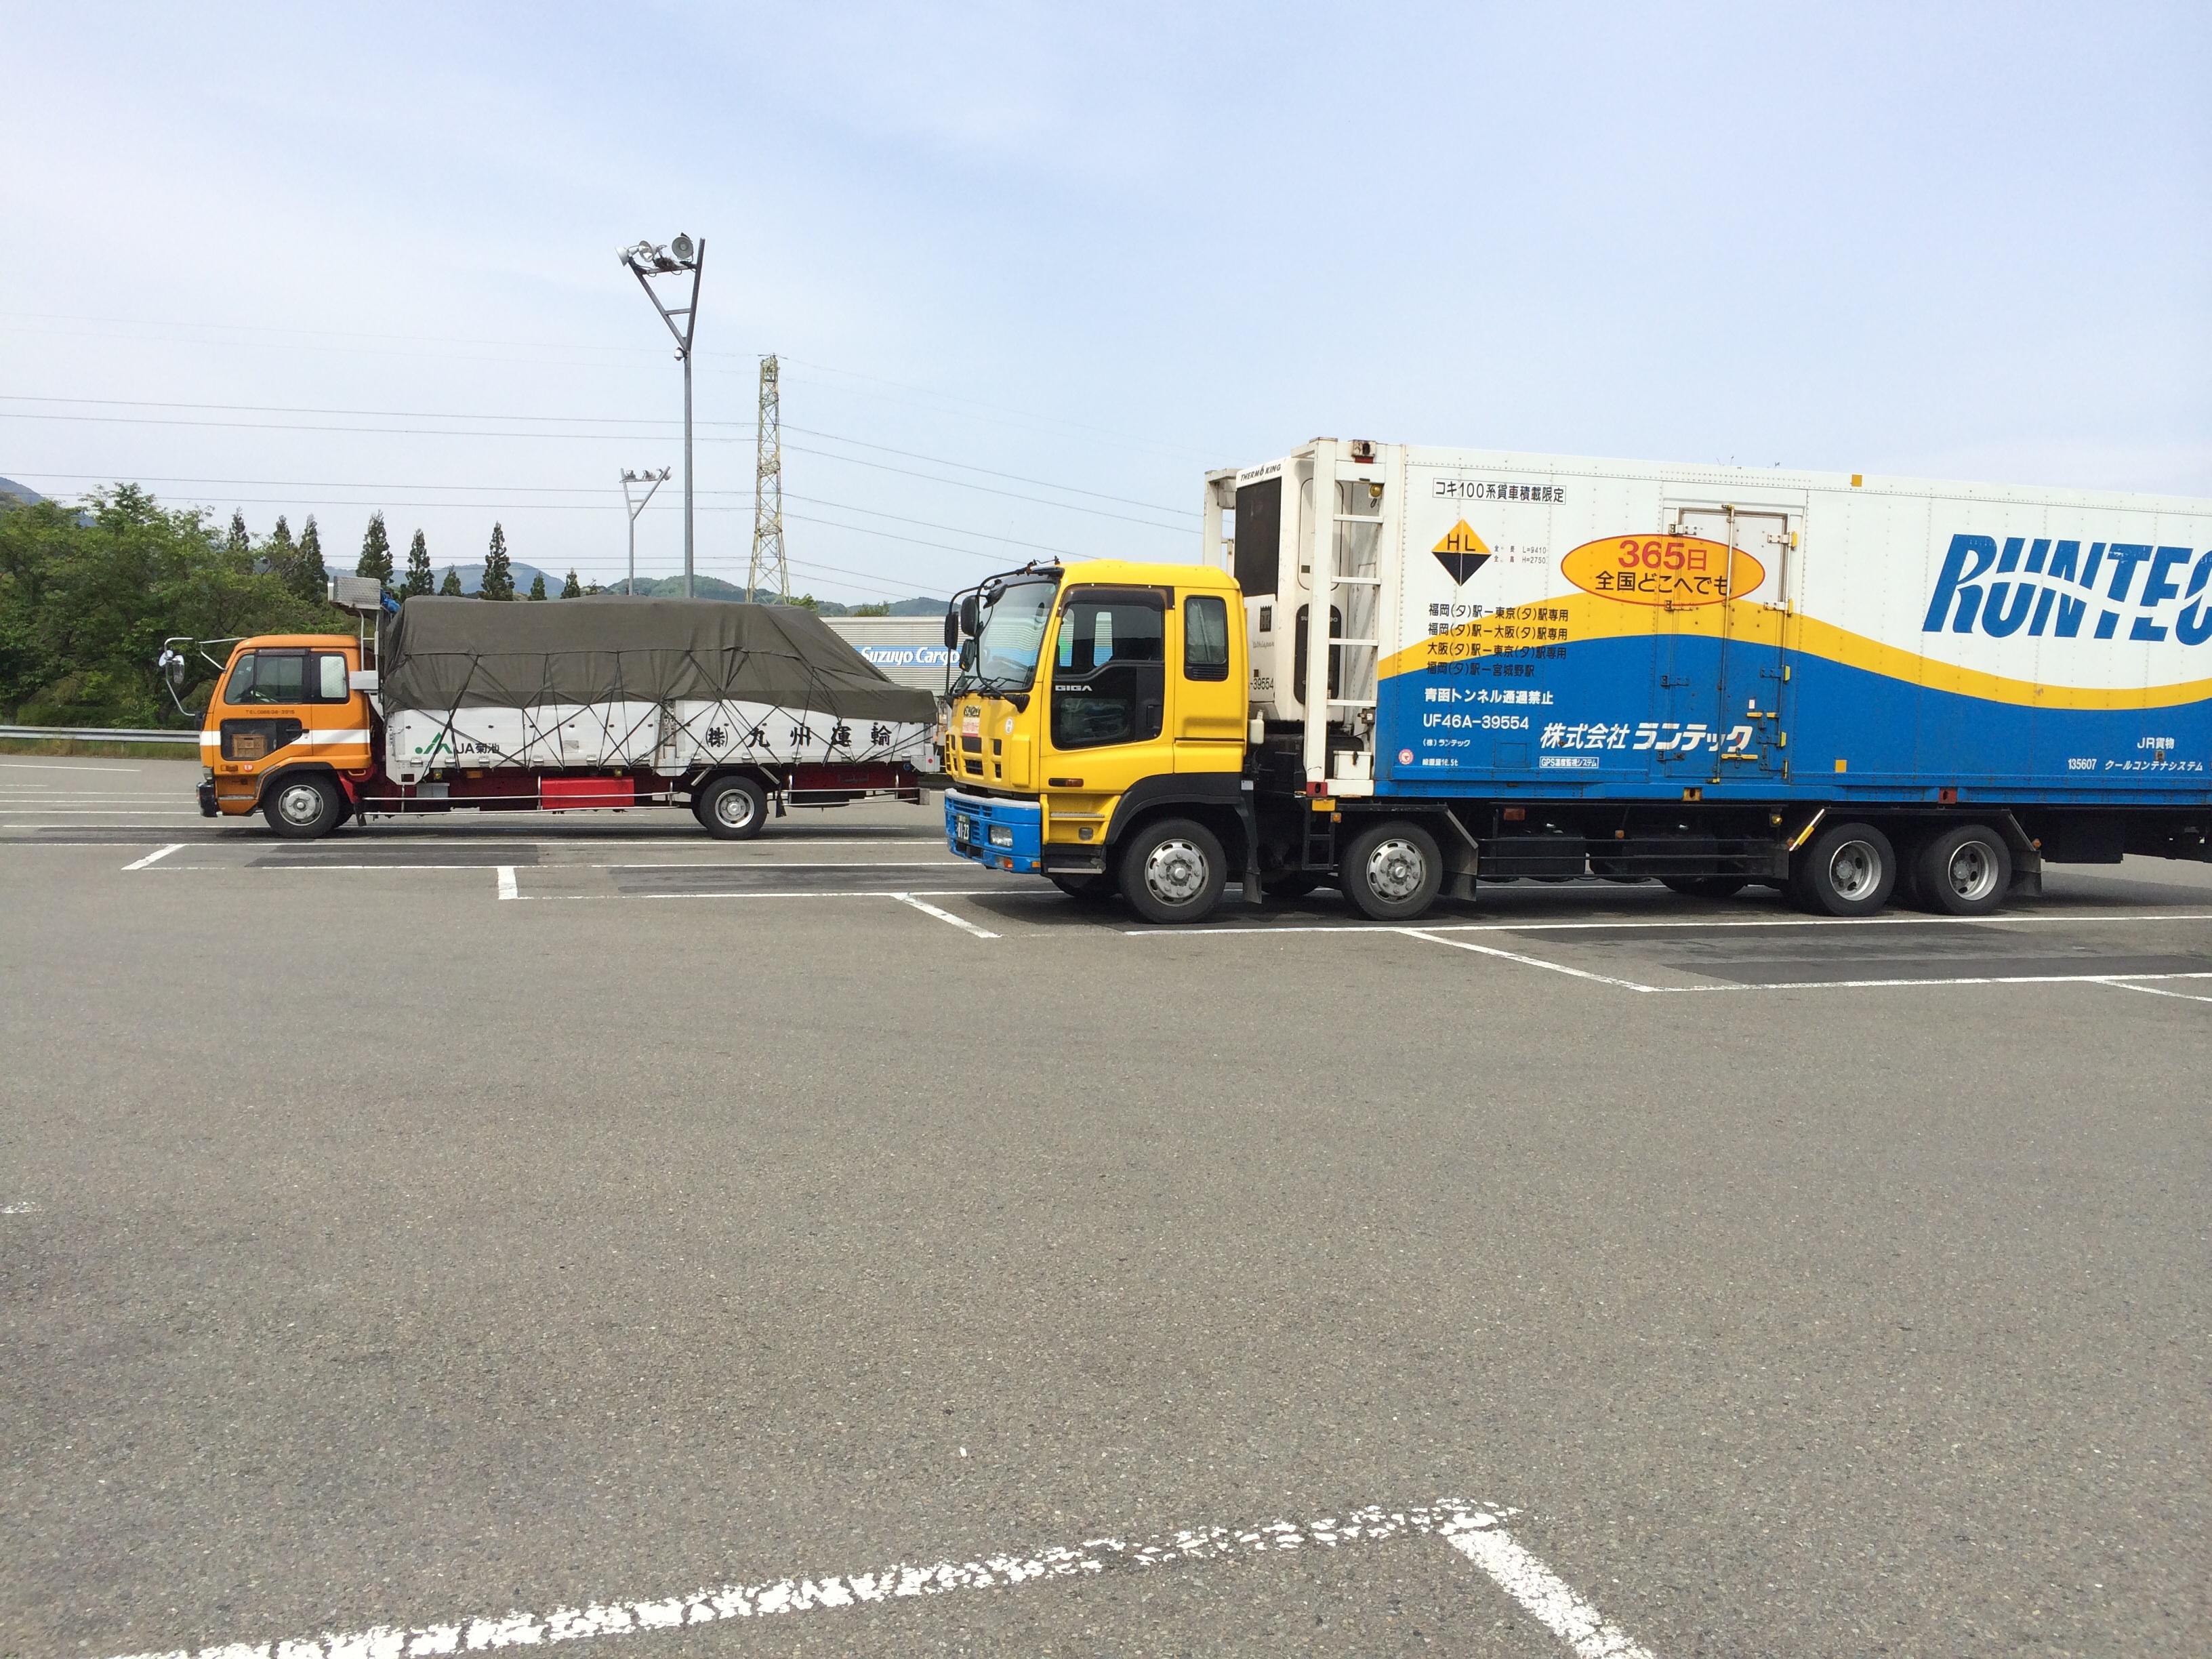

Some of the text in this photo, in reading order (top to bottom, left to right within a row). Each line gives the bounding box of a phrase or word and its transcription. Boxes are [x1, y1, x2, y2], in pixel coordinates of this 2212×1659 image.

[1240, 463, 1282, 482] THERMO KING
[1435, 480, 1564, 503] コキ100系貨車積載限定
[1618, 539, 1708, 571] 365日
[1595, 570, 1732, 596] 全国どこへでも
[861, 646, 960, 666] Suzuyo Cargo
[1425, 688, 1554, 705] 青函トンネル通過禁止
[1423, 714, 1530, 730] UF46A-39554
[1540, 722, 1753, 753] 株式会社 ランテック
[2137, 737, 2175, 750] JR貨物
[2068, 758, 2203, 772] 135607 クールコンテナシステム
